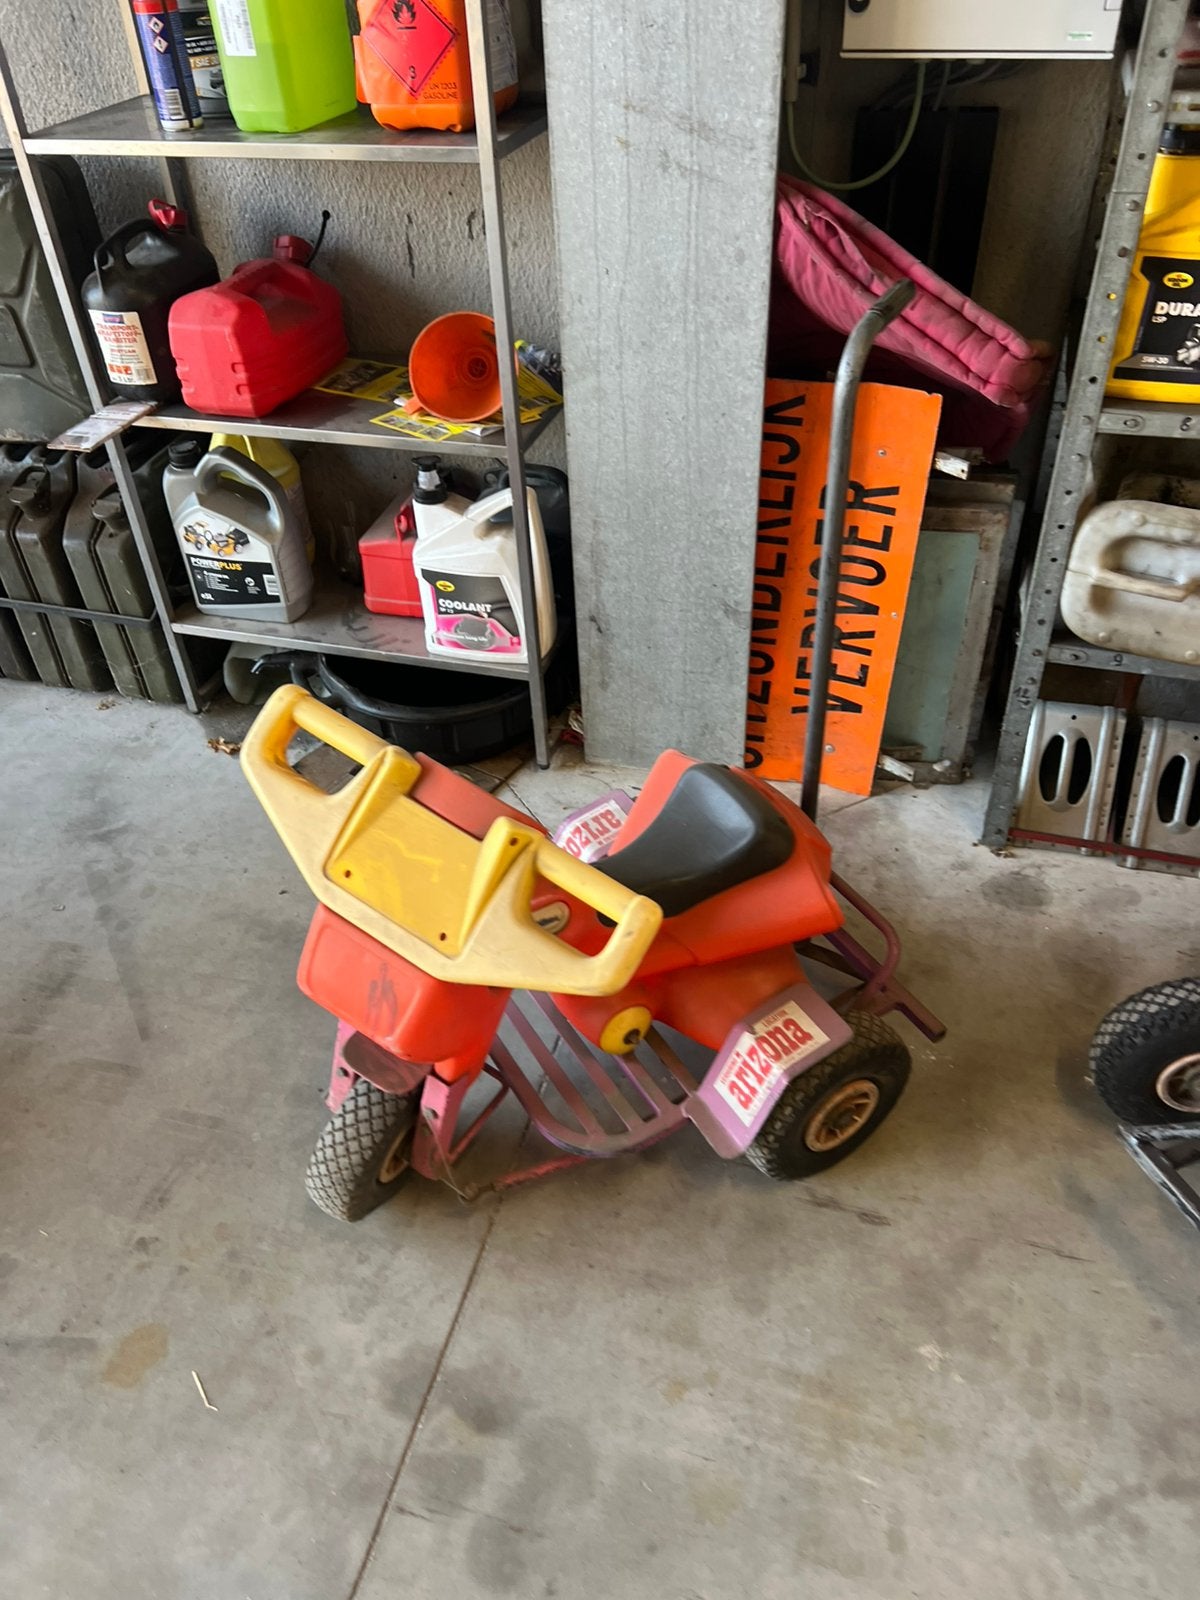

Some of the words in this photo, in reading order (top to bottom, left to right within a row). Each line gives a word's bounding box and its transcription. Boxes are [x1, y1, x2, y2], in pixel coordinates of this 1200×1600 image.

[409, 65, 417, 80] 3
[438, 598, 492, 613] COOLANT
[791, 480, 900, 715] VERVOER
[562, 809, 622, 858] arizo
[728, 1017, 814, 1110] arizona
